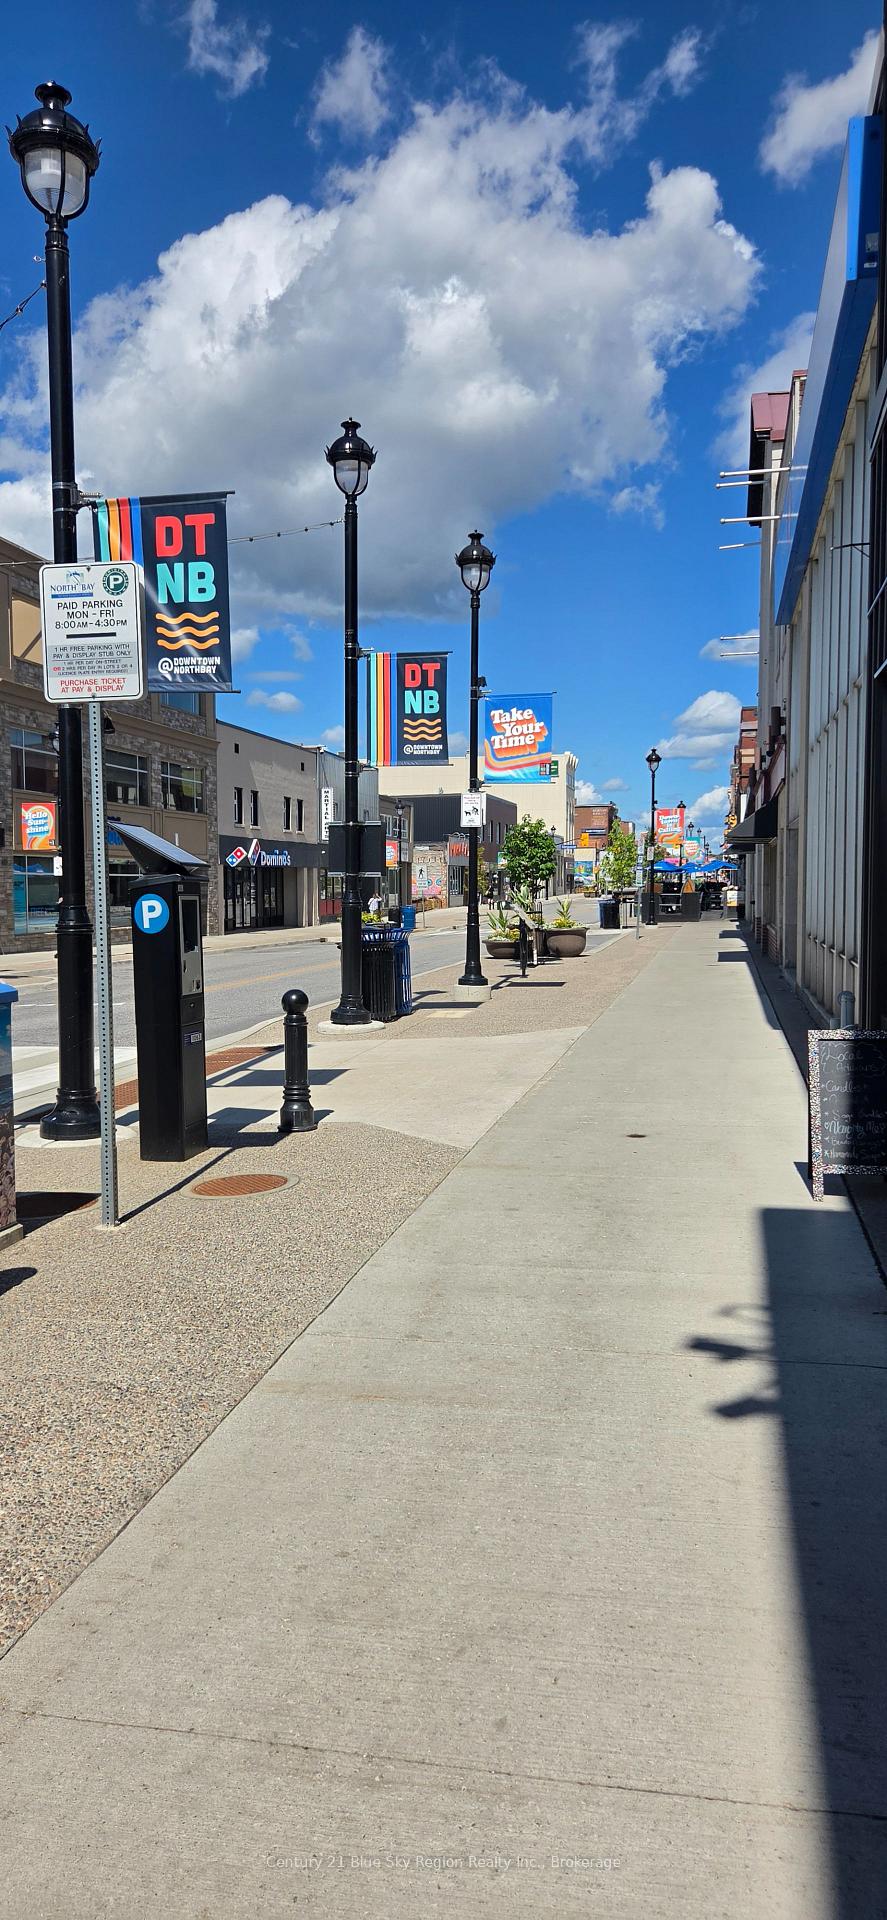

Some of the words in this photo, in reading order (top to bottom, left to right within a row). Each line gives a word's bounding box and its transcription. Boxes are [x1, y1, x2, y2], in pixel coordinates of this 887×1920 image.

[155, 512, 215, 557] DT
[156, 562, 216, 604] NB
[58, 602, 78, 610] PAID
[82, 599, 123, 609] PARKING
[67, 610, 88, 619] MON
[100, 609, 114, 618] FRI
[174, 664, 216, 674] NORTHBAY
[405, 663, 440, 688] DT
[404, 690, 440, 714] NB
[490, 707, 533, 724] Take
[502, 721, 544, 736] Your
[491, 734, 535, 749] Time
[25, 812, 47, 820] Hello
[26, 825, 49, 833] shine
[260, 849, 291, 866] Domino's
[141, 900, 162, 929] P
